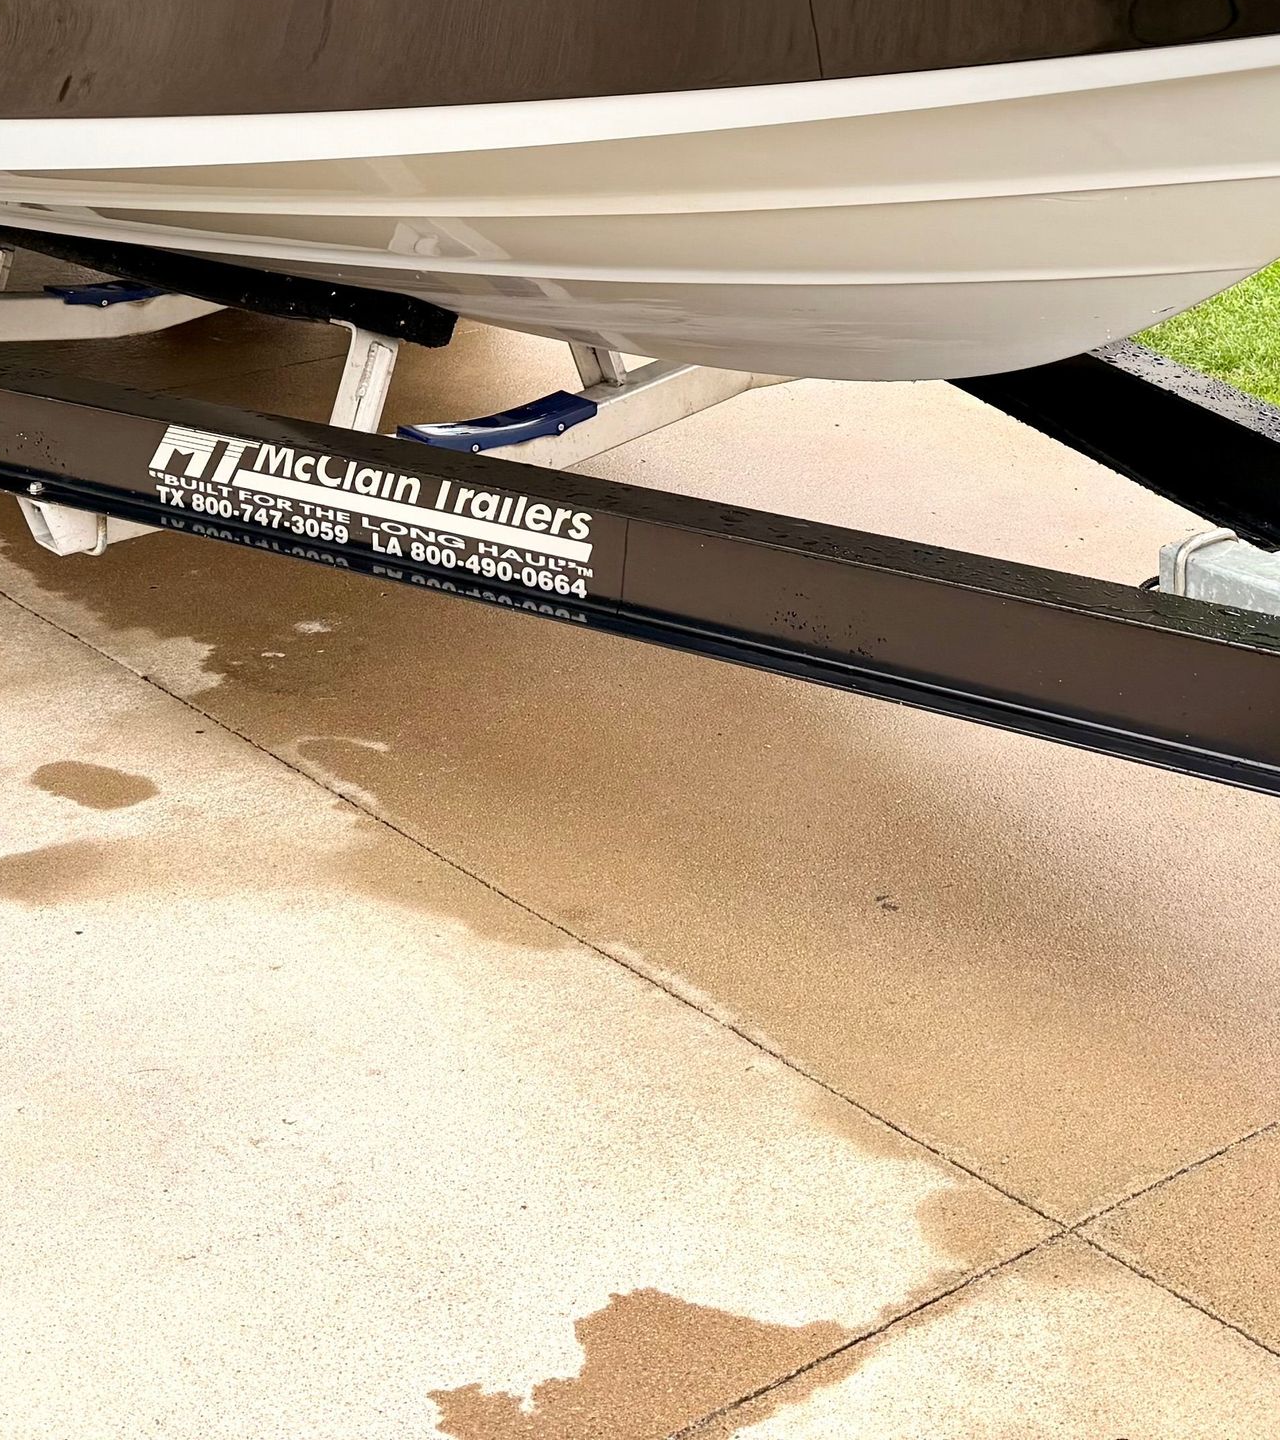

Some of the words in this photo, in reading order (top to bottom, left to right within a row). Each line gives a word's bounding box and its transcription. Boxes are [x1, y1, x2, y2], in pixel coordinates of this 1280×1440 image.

[238, 490, 293, 512] FOR
[298, 502, 351, 525] THE
[361, 516, 466, 550] LONG
[252, 443, 421, 505] McClain
[435, 480, 593, 540] Trailers
[156, 484, 185, 509] TX
[191, 493, 349, 545] 800-747-3059
[372, 532, 403, 558] LA
[410, 541, 588, 599] 800-490-0664
